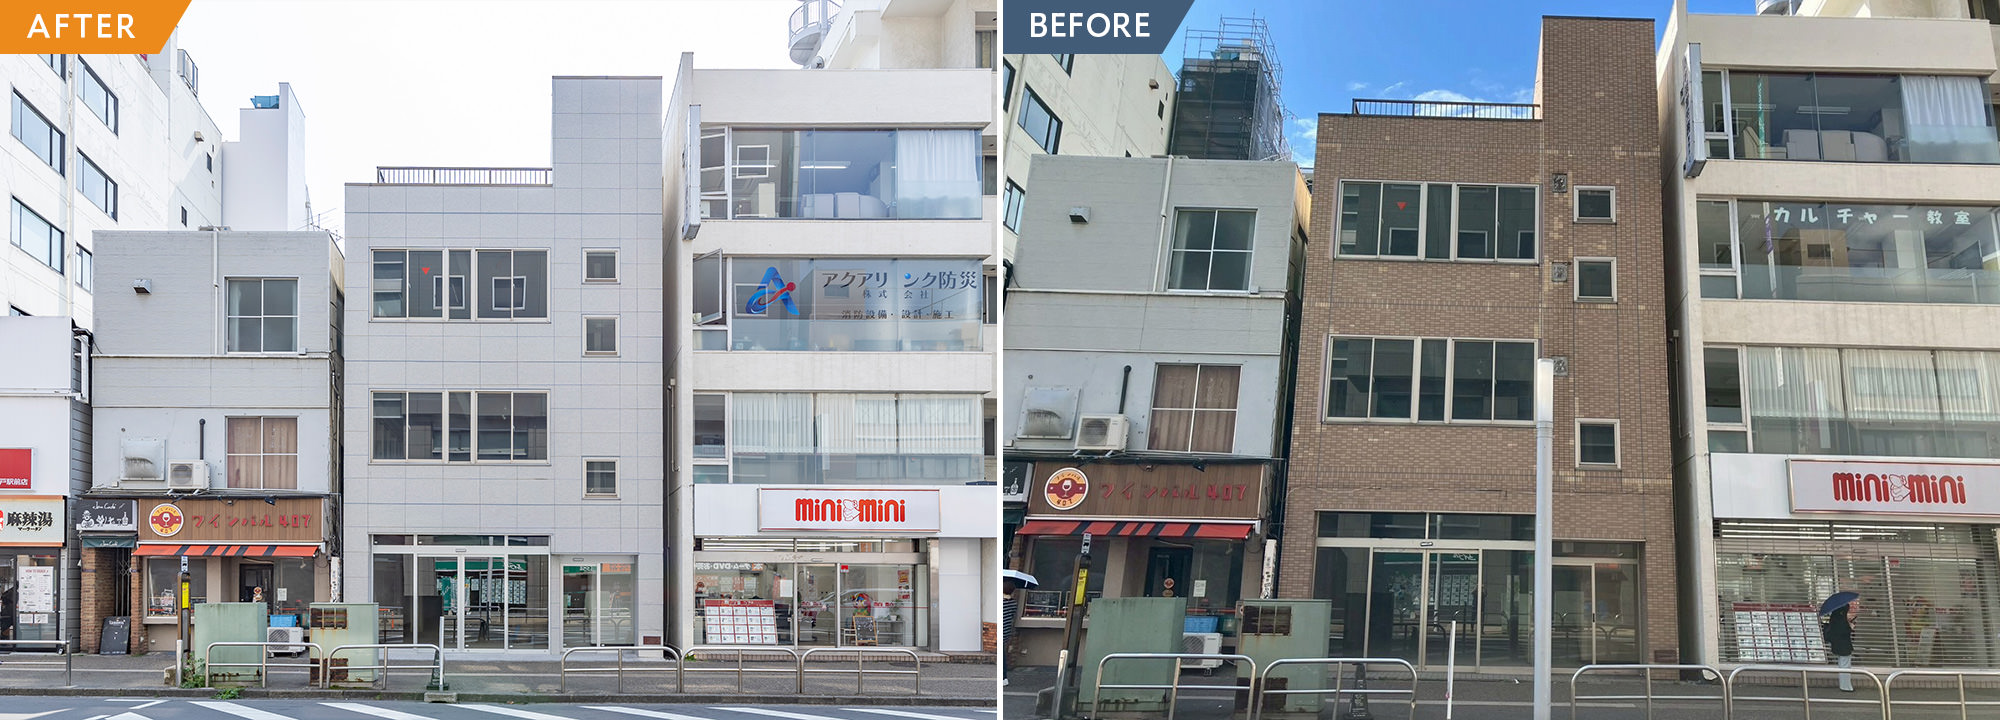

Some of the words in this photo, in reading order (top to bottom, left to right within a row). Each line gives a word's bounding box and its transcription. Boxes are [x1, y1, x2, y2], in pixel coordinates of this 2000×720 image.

[1773, 206, 1971, 225] カルチャー教室
[863, 289, 929, 299] 株式会社
[1101, 483, 1198, 500] ワインバル
[1208, 484, 1247, 500] 407
[1832, 471, 1890, 503] mini
[1908, 473, 1967, 505] mini
[795, 498, 842, 522] mini
[859, 498, 906, 522] mini
[6, 511, 53, 527] 麻辣湯
[192, 513, 273, 528] ワインバル
[279, 513, 312, 528] 407
